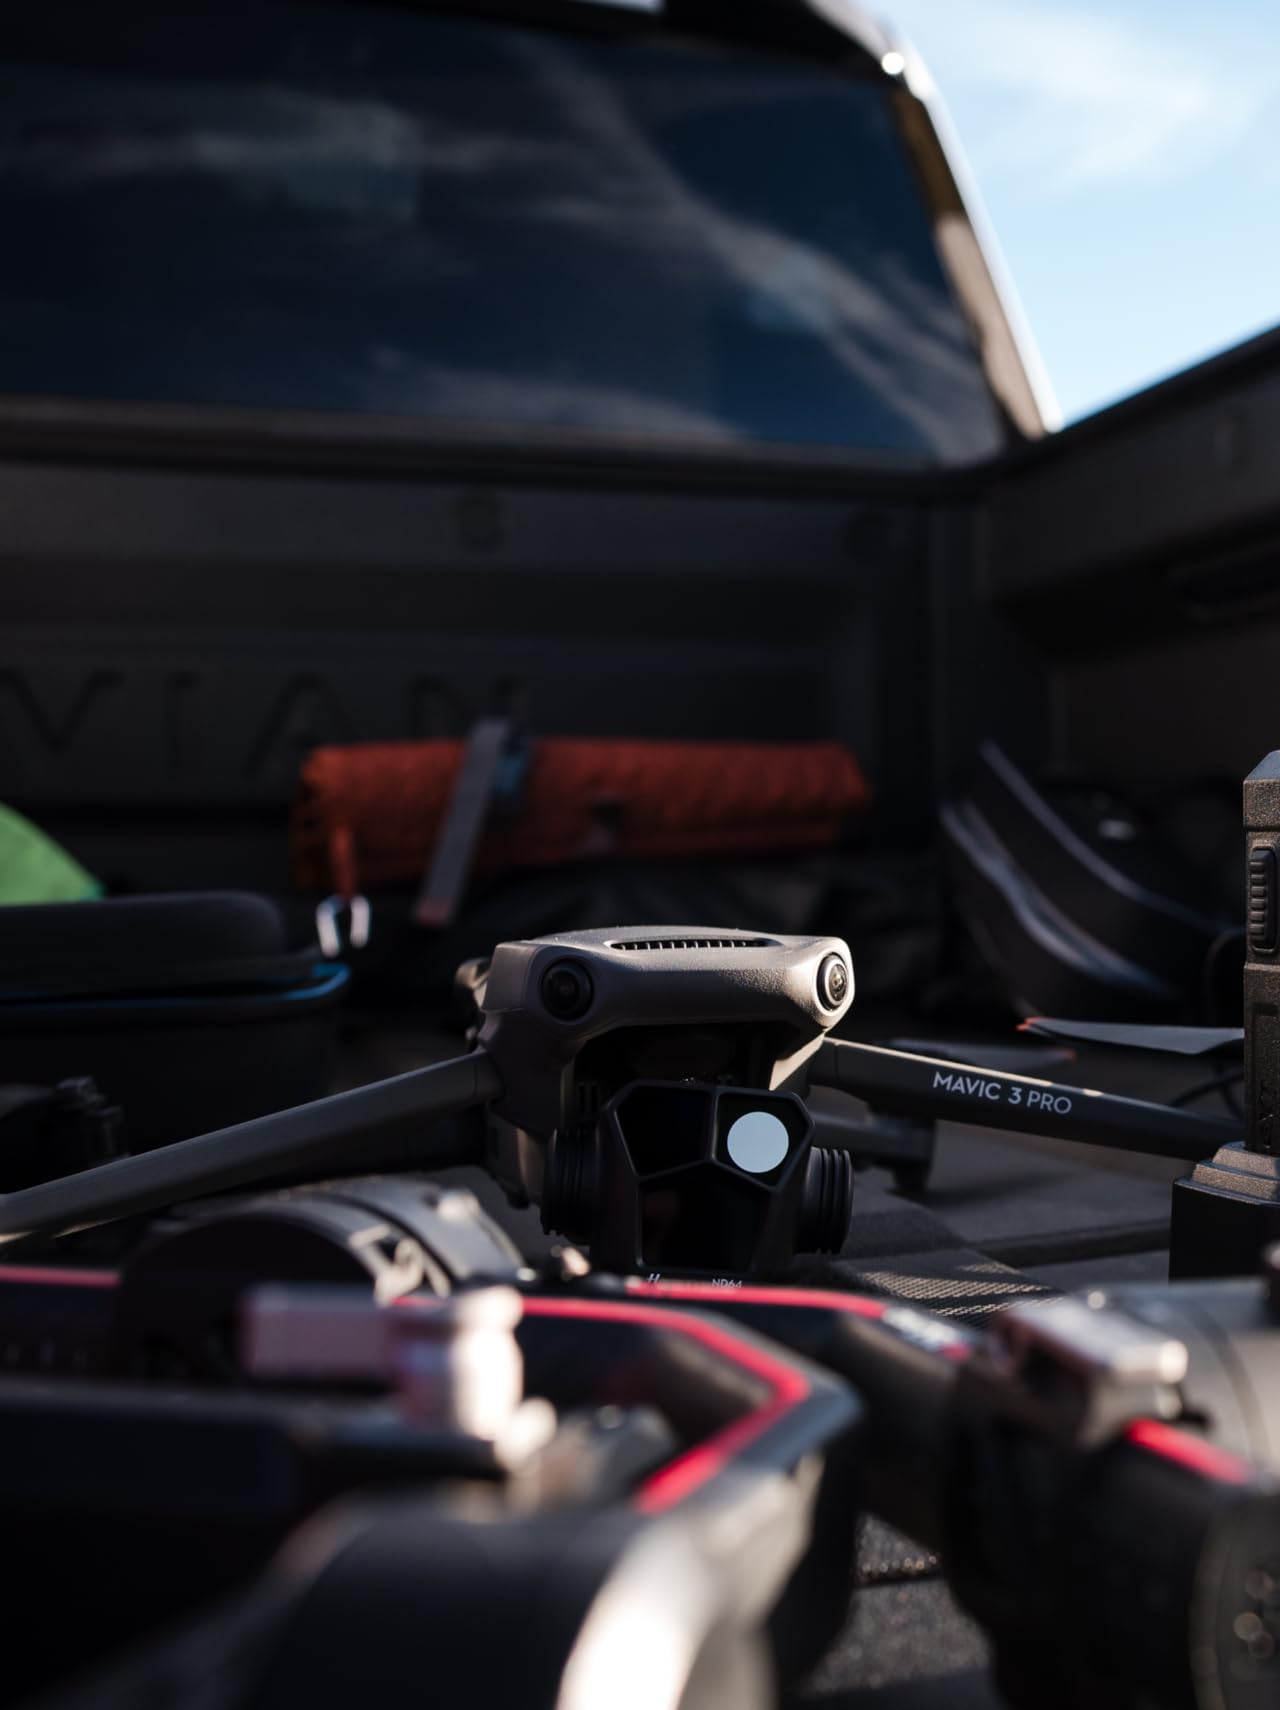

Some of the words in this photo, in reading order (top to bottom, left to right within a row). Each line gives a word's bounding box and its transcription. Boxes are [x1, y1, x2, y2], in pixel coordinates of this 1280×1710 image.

[933, 1071, 1001, 1100] MAVIC
[1008, 1087, 1023, 1104] 3
[1027, 1090, 1072, 1114] PRO
[712, 1278, 742, 1289] ND64
